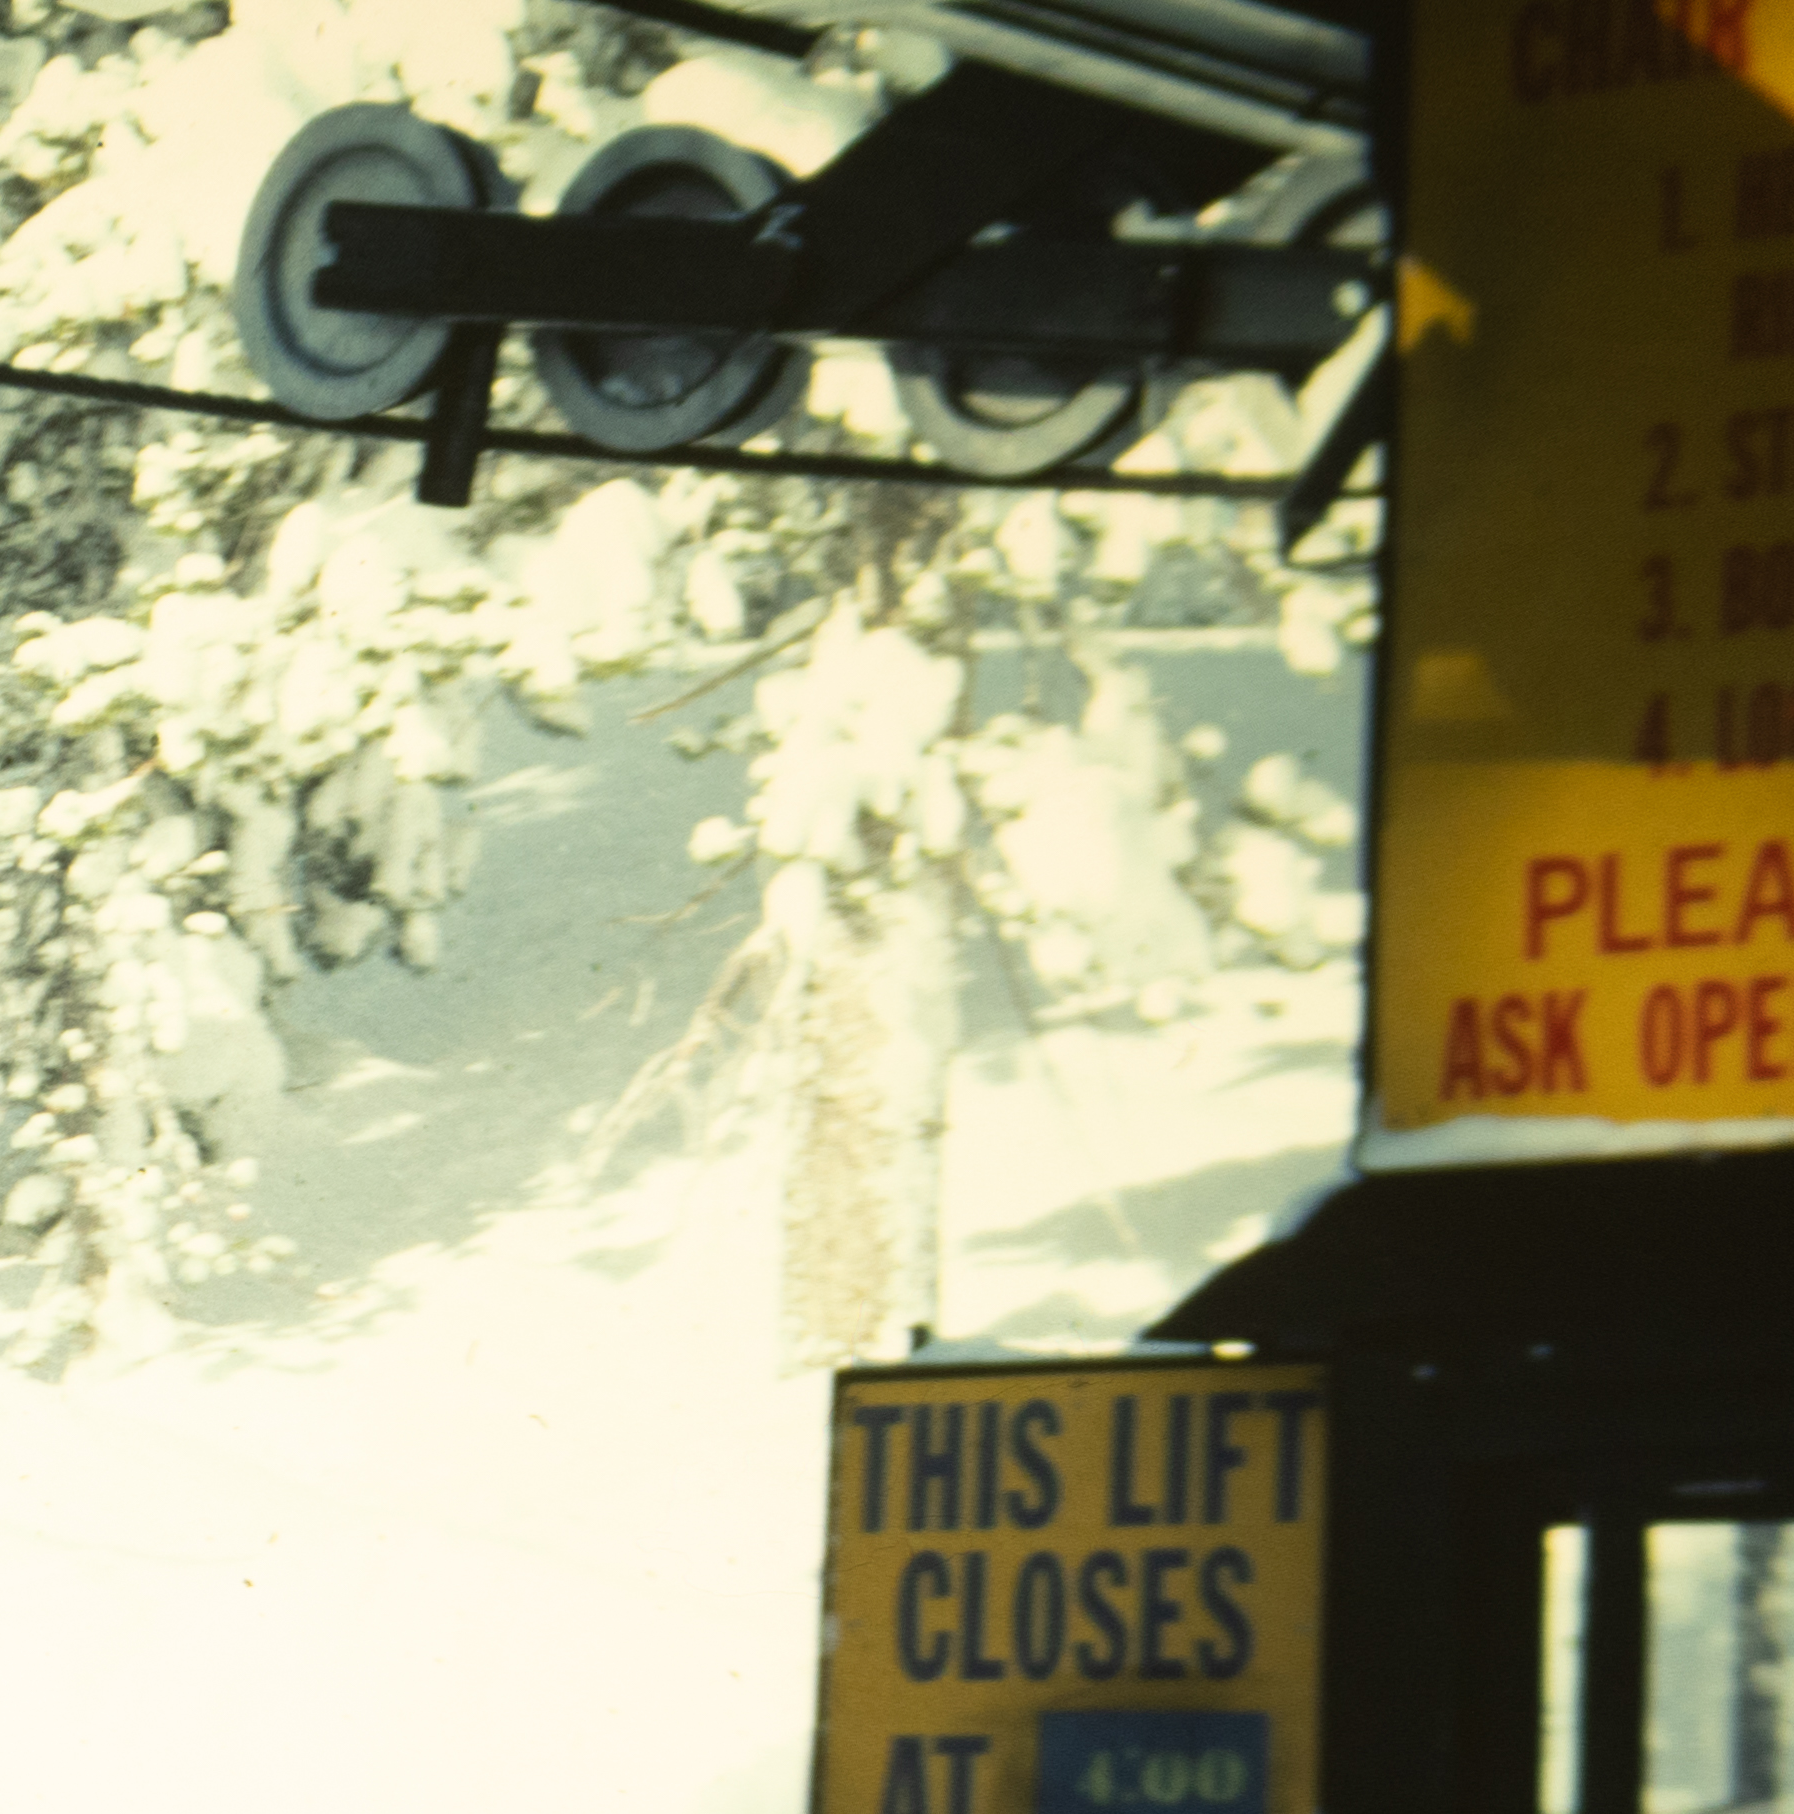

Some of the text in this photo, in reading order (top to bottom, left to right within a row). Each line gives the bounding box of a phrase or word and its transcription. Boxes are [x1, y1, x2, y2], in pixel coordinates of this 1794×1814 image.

[1436, 986, 1593, 1102] ASK
[852, 1390, 1318, 1534] THIS LIFT
[895, 1545, 1257, 1684] CLOSES
